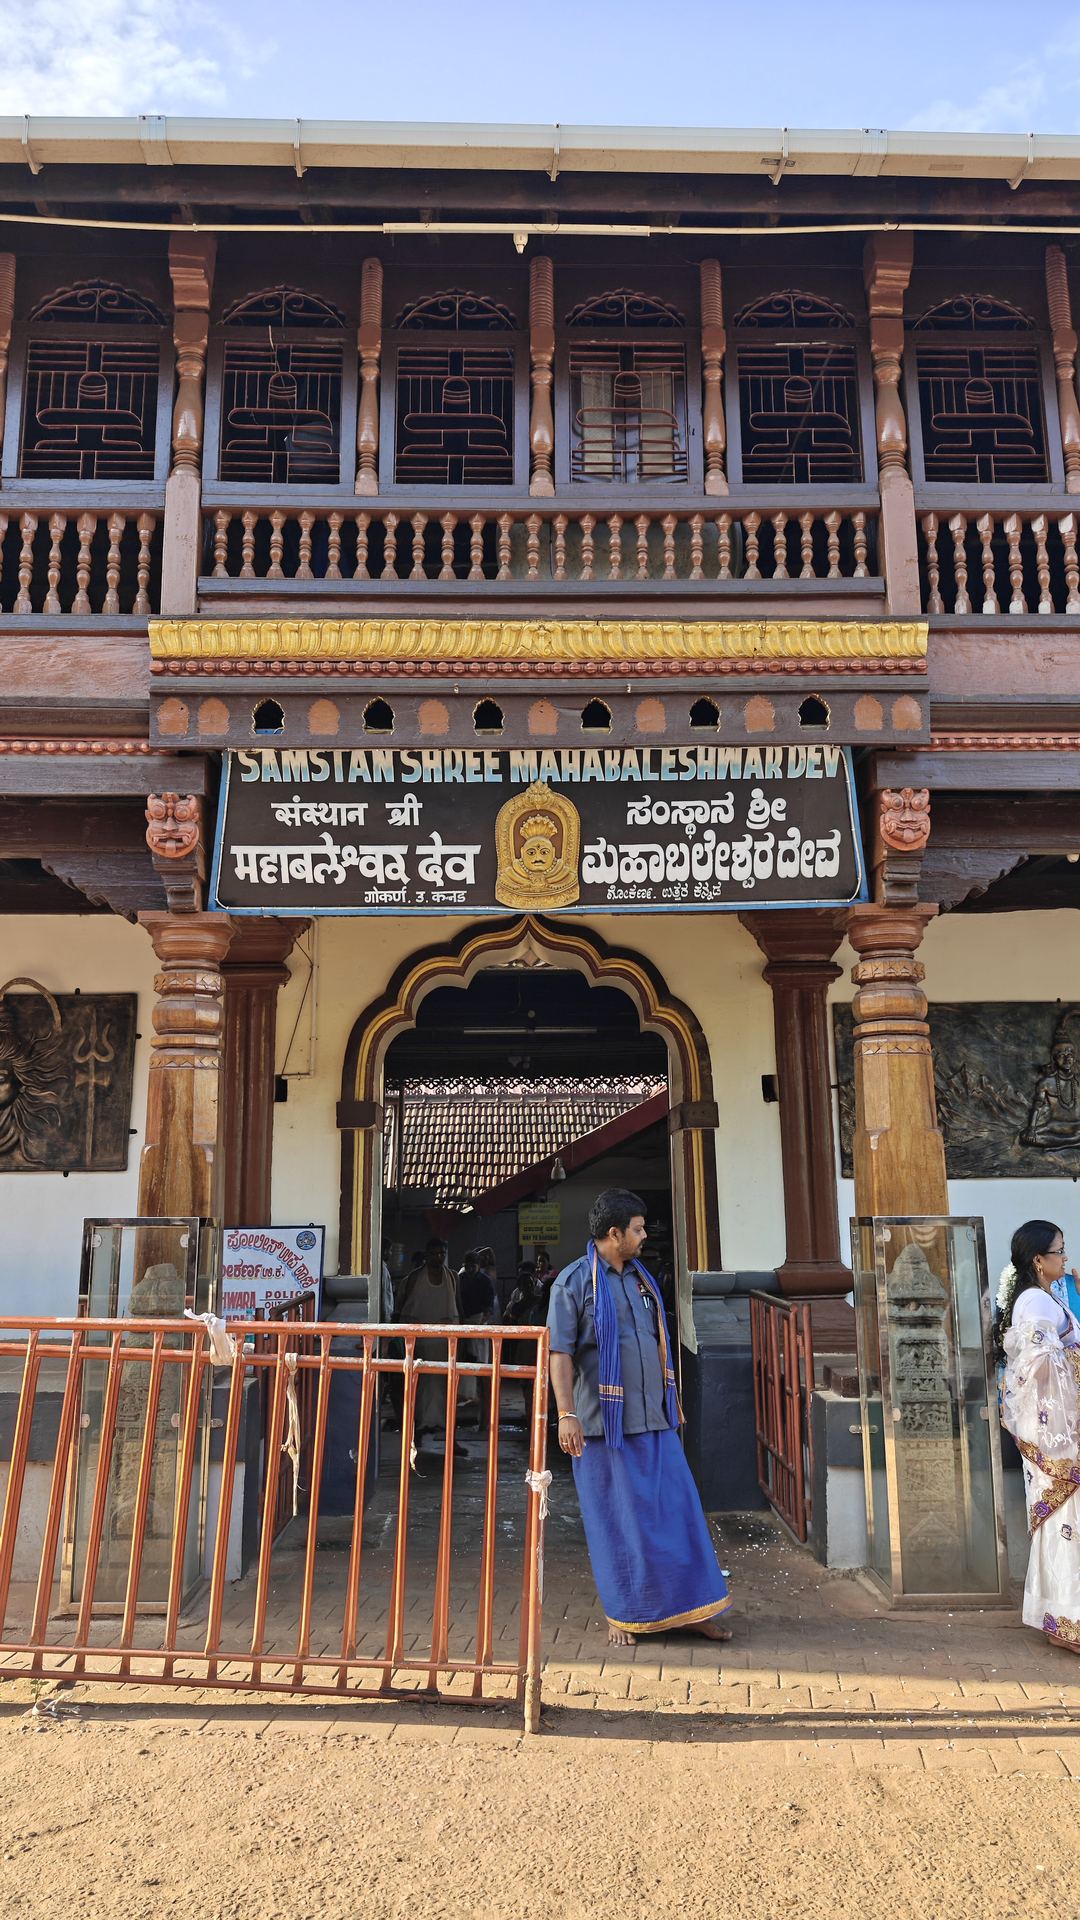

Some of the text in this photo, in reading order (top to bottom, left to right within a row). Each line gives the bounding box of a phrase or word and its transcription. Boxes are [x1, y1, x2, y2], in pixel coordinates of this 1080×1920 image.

[239, 744, 841, 784] SAMSTAN SHREE MAHABALESHWAR DEV
[270, 792, 423, 827] संस्थान श्री
[626, 787, 787, 840] ಸಂಸ್ಥಾನ ಶ್ರೀ
[230, 831, 481, 887] महाबलेश्वर देव
